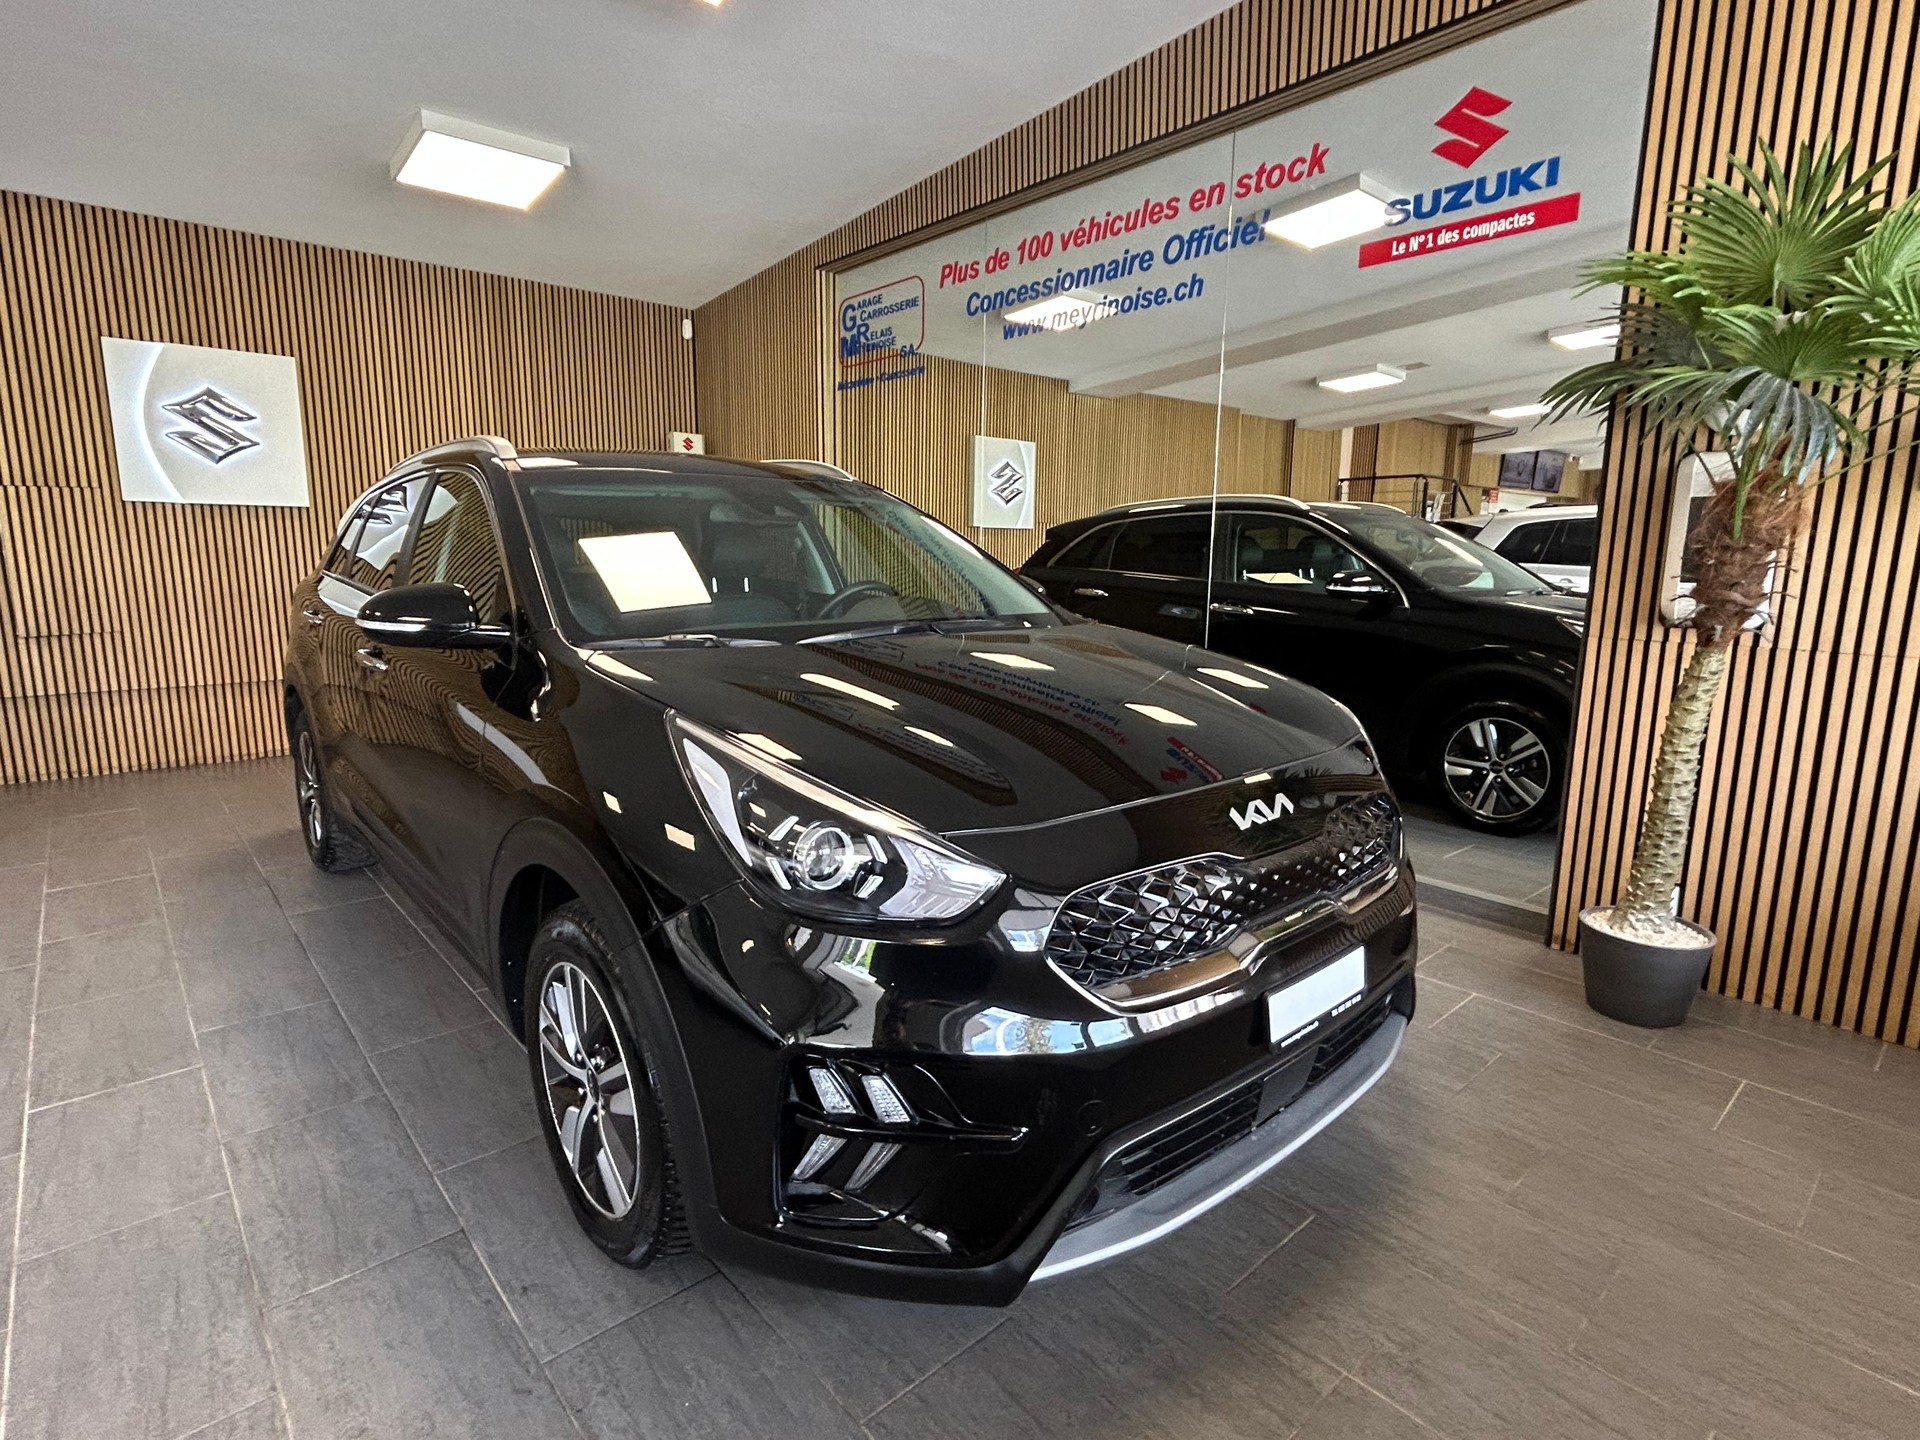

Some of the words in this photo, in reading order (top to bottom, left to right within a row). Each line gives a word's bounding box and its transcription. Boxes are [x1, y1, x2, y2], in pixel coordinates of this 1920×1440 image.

[939, 261, 980, 289] Plus
[985, 247, 1010, 274] de
[1017, 231, 1054, 264] 100
[1060, 198, 1181, 251] véhicules
[1189, 182, 1226, 211] en
[1234, 143, 1330, 199] stock
[1384, 156, 1560, 226] SUZUKI
[1391, 240, 1406, 256] Le
[1437, 228, 1460, 246] des
[1462, 211, 1536, 240] compactes
[966, 248, 1154, 316] Concessionnaire
[1162, 208, 1271, 265] Officiel
[856, 323, 893, 343] RELAIS
[860, 296, 920, 322] CARROSSERIE
[1003, 273, 1204, 340] www.meyrinoise.ch
[1229, 792, 1294, 831] KIA
